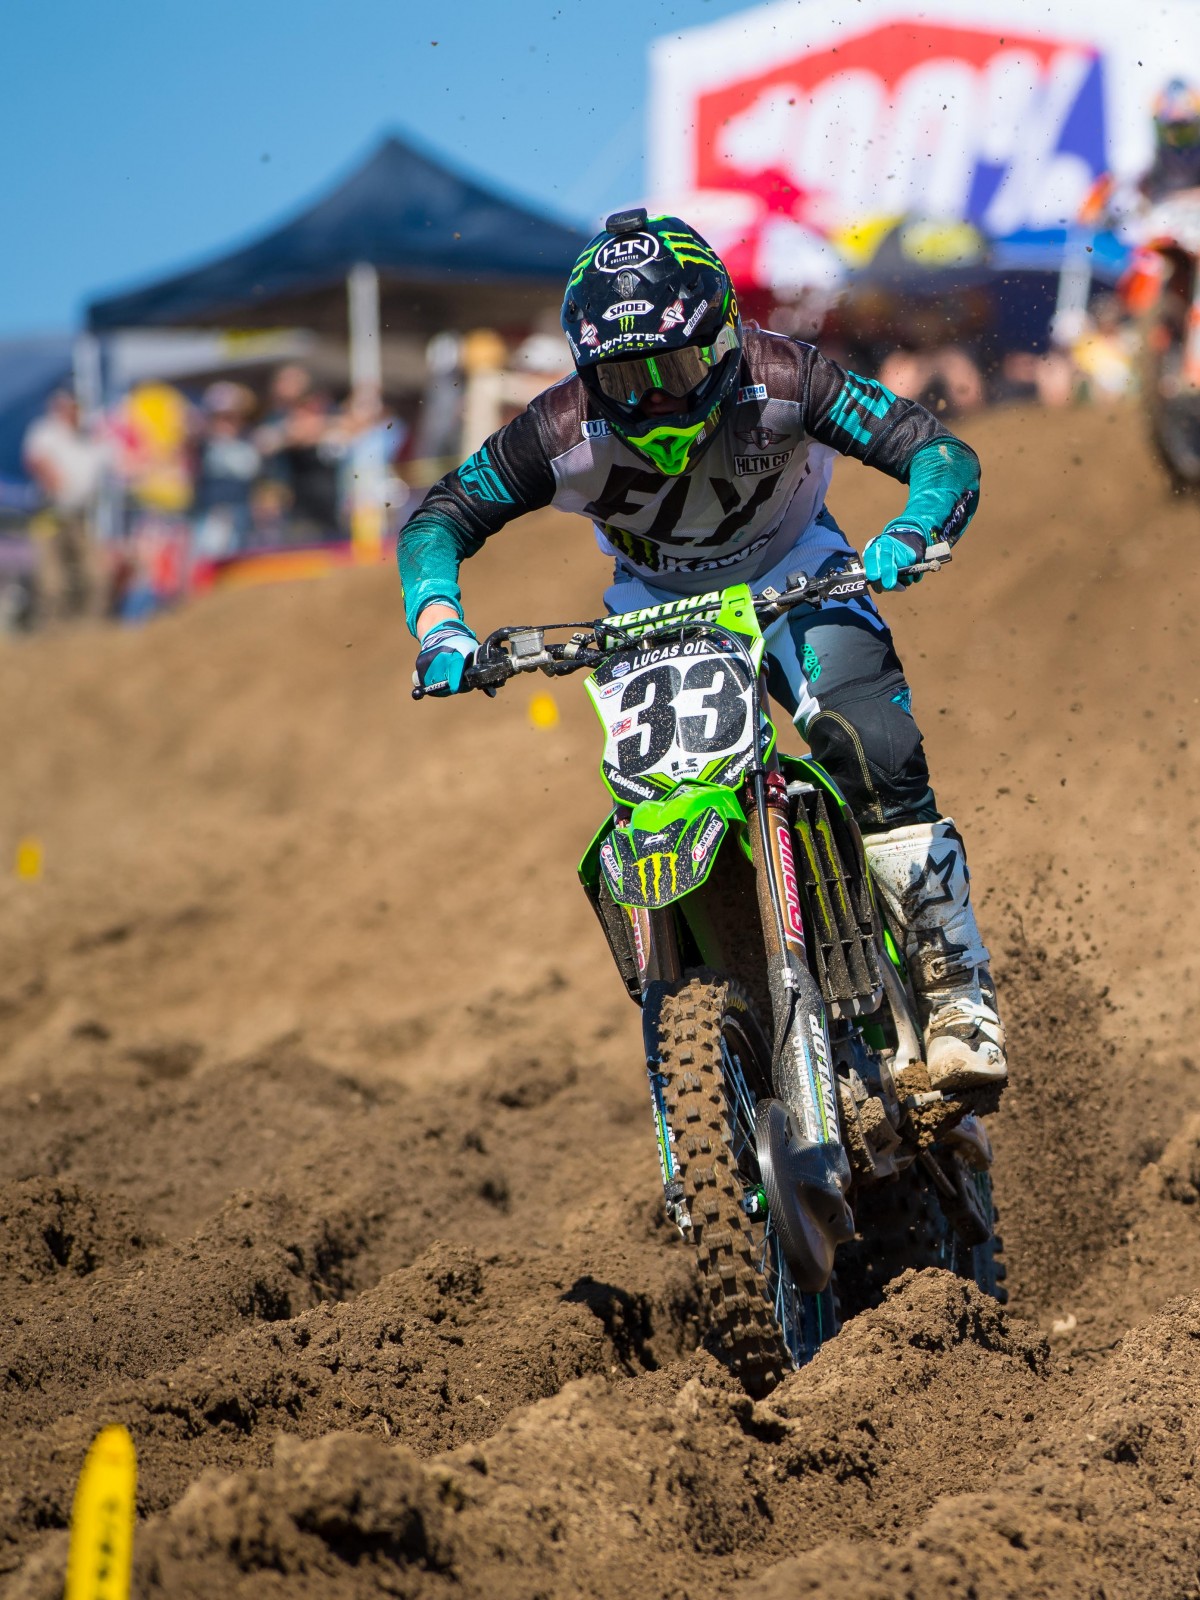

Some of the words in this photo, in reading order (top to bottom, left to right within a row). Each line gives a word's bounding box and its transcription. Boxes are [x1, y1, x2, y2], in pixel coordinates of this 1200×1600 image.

[609, 303, 646, 317] SHOEI
[589, 332, 667, 357] MONSTER
[599, 341, 654, 358] ENERGY
[736, 456, 770, 474] HLTN
[772, 452, 790, 465] CO
[583, 464, 784, 547] FLY
[828, 579, 866, 596] ARC
[602, 589, 725, 629] RENTHA
[632, 645, 680, 671] LUCAS
[683, 640, 710, 655] OIL
[617, 657, 751, 777] 33
[672, 767, 699, 778] Kawasaki
[724, 733, 770, 781] Kawaski
[608, 768, 655, 800] Kawasaki
[792, 1035, 813, 1107] CARRILLO
[808, 1013, 840, 1144] DUNLOP
